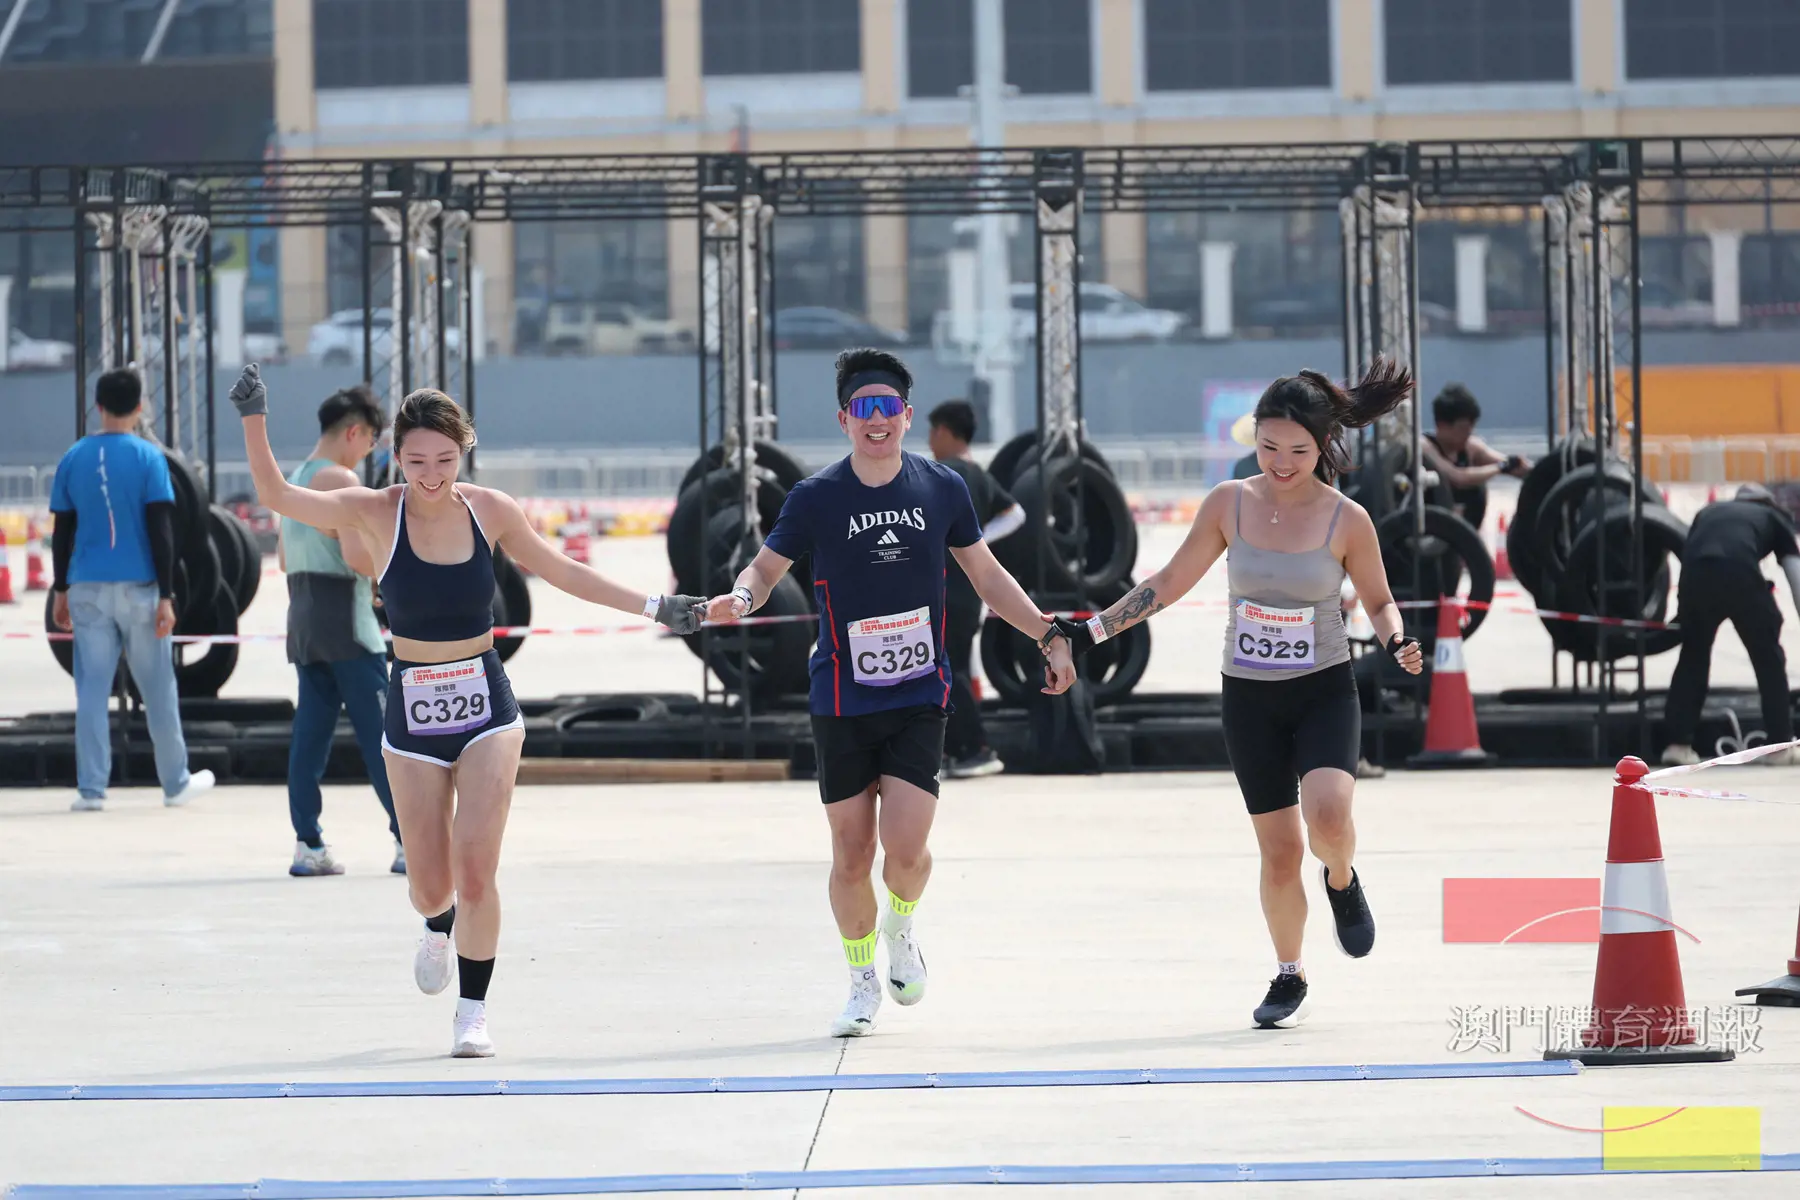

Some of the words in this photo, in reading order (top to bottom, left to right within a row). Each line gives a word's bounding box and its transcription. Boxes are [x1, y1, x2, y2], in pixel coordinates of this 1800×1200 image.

[847, 507, 926, 540] ADIDAS
[857, 641, 930, 675] C329
[1238, 633, 1310, 659] C329
[410, 692, 485, 724] C329
